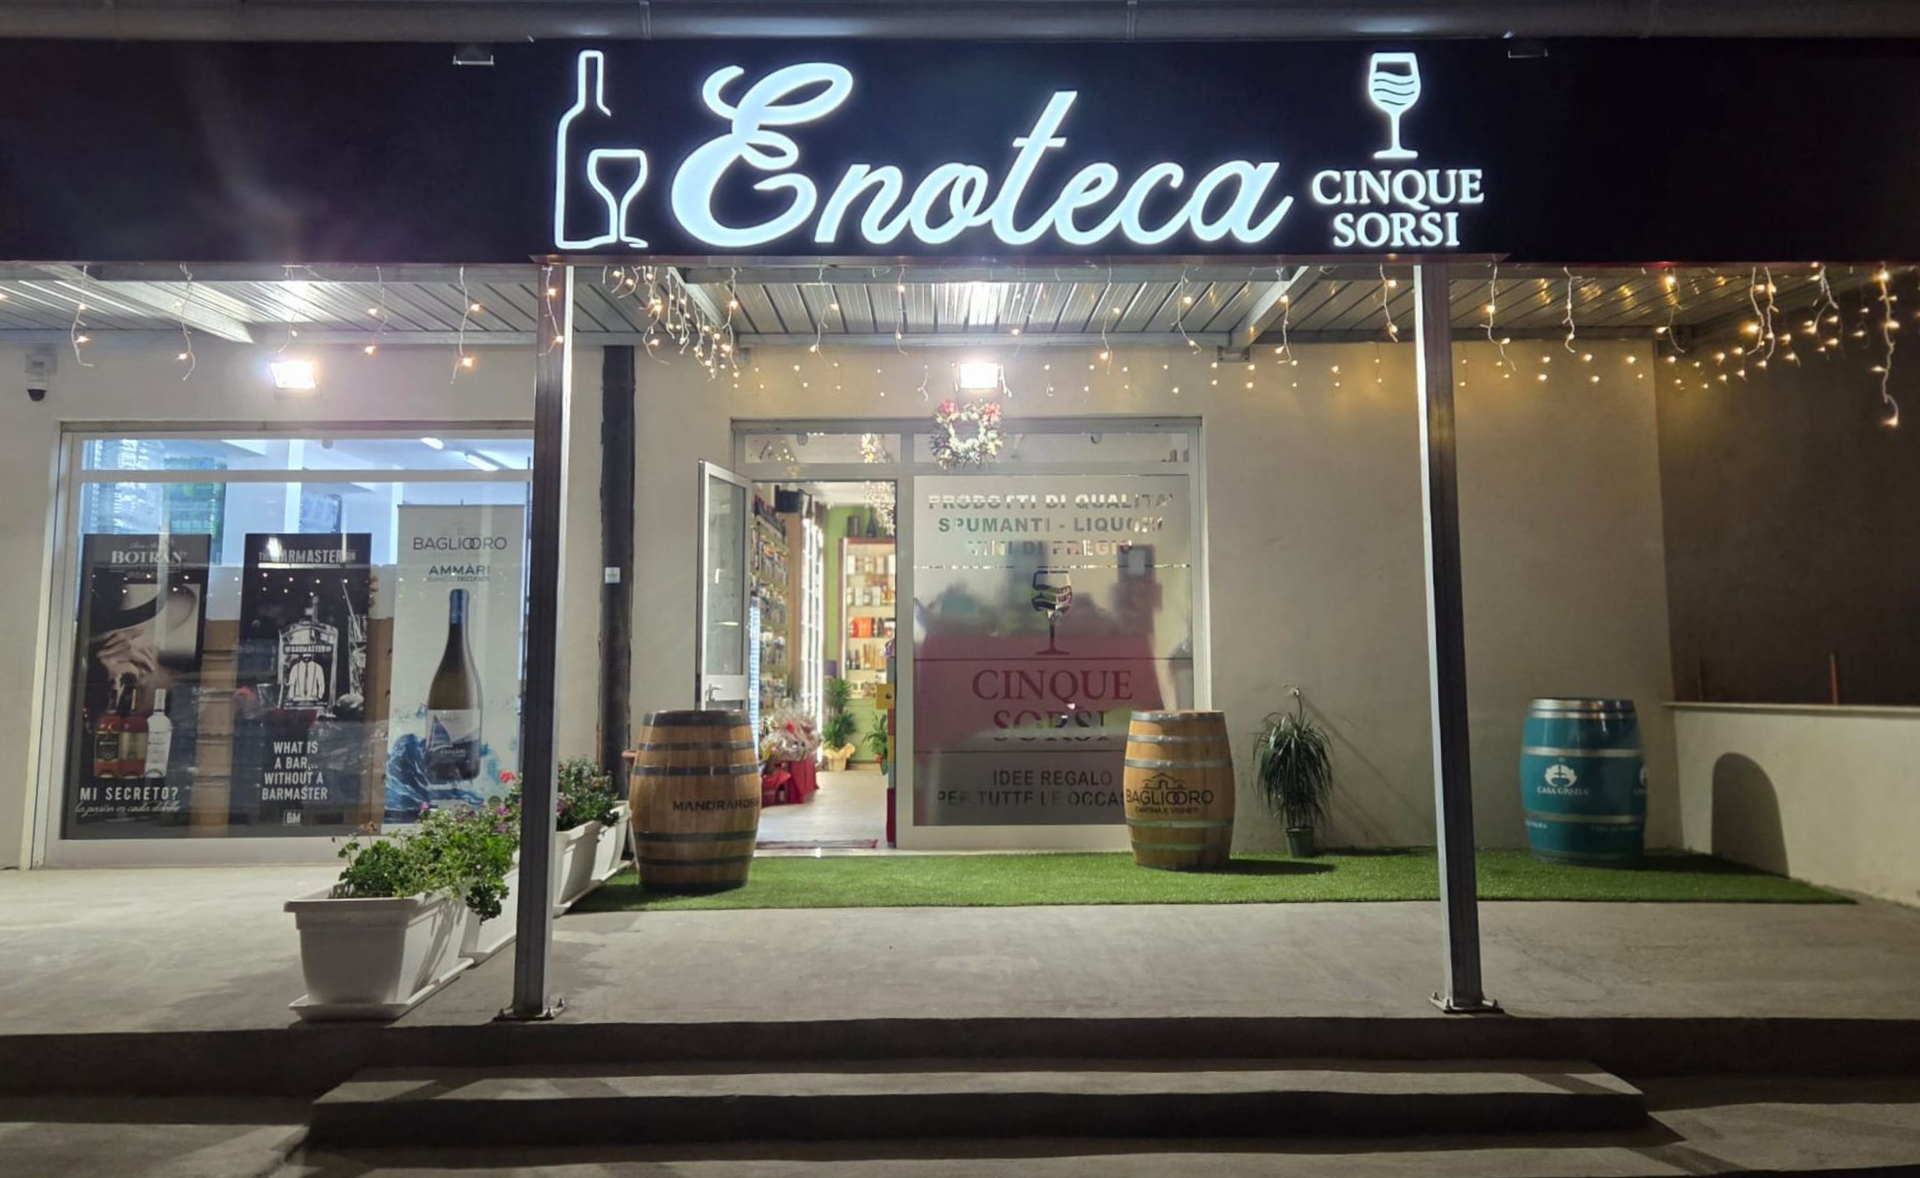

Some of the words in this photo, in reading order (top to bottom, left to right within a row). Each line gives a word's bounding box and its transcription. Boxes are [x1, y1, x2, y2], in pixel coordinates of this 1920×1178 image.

[671, 61, 1294, 248] Enoteca
[1311, 168, 1485, 211] CINQUE
[1333, 212, 1460, 247] SORSI
[1045, 494, 1066, 509] DI
[938, 517, 1050, 533] SPUMANTI
[111, 550, 182, 564] BOTRAN
[972, 669, 1134, 707] CINQUE
[273, 741, 304, 754] WHAT
[306, 741, 319, 754] IS
[274, 756, 282, 770] A
[264, 771, 313, 785] WITHOUT
[316, 771, 324, 785] A
[993, 770, 1034, 786] IDEE
[1040, 770, 1113, 786] REGALO
[80, 787, 98, 801] MI
[105, 786, 179, 801] SECRETO?
[261, 787, 328, 801] BARMASTER
[978, 790, 1034, 806] TUTTE
